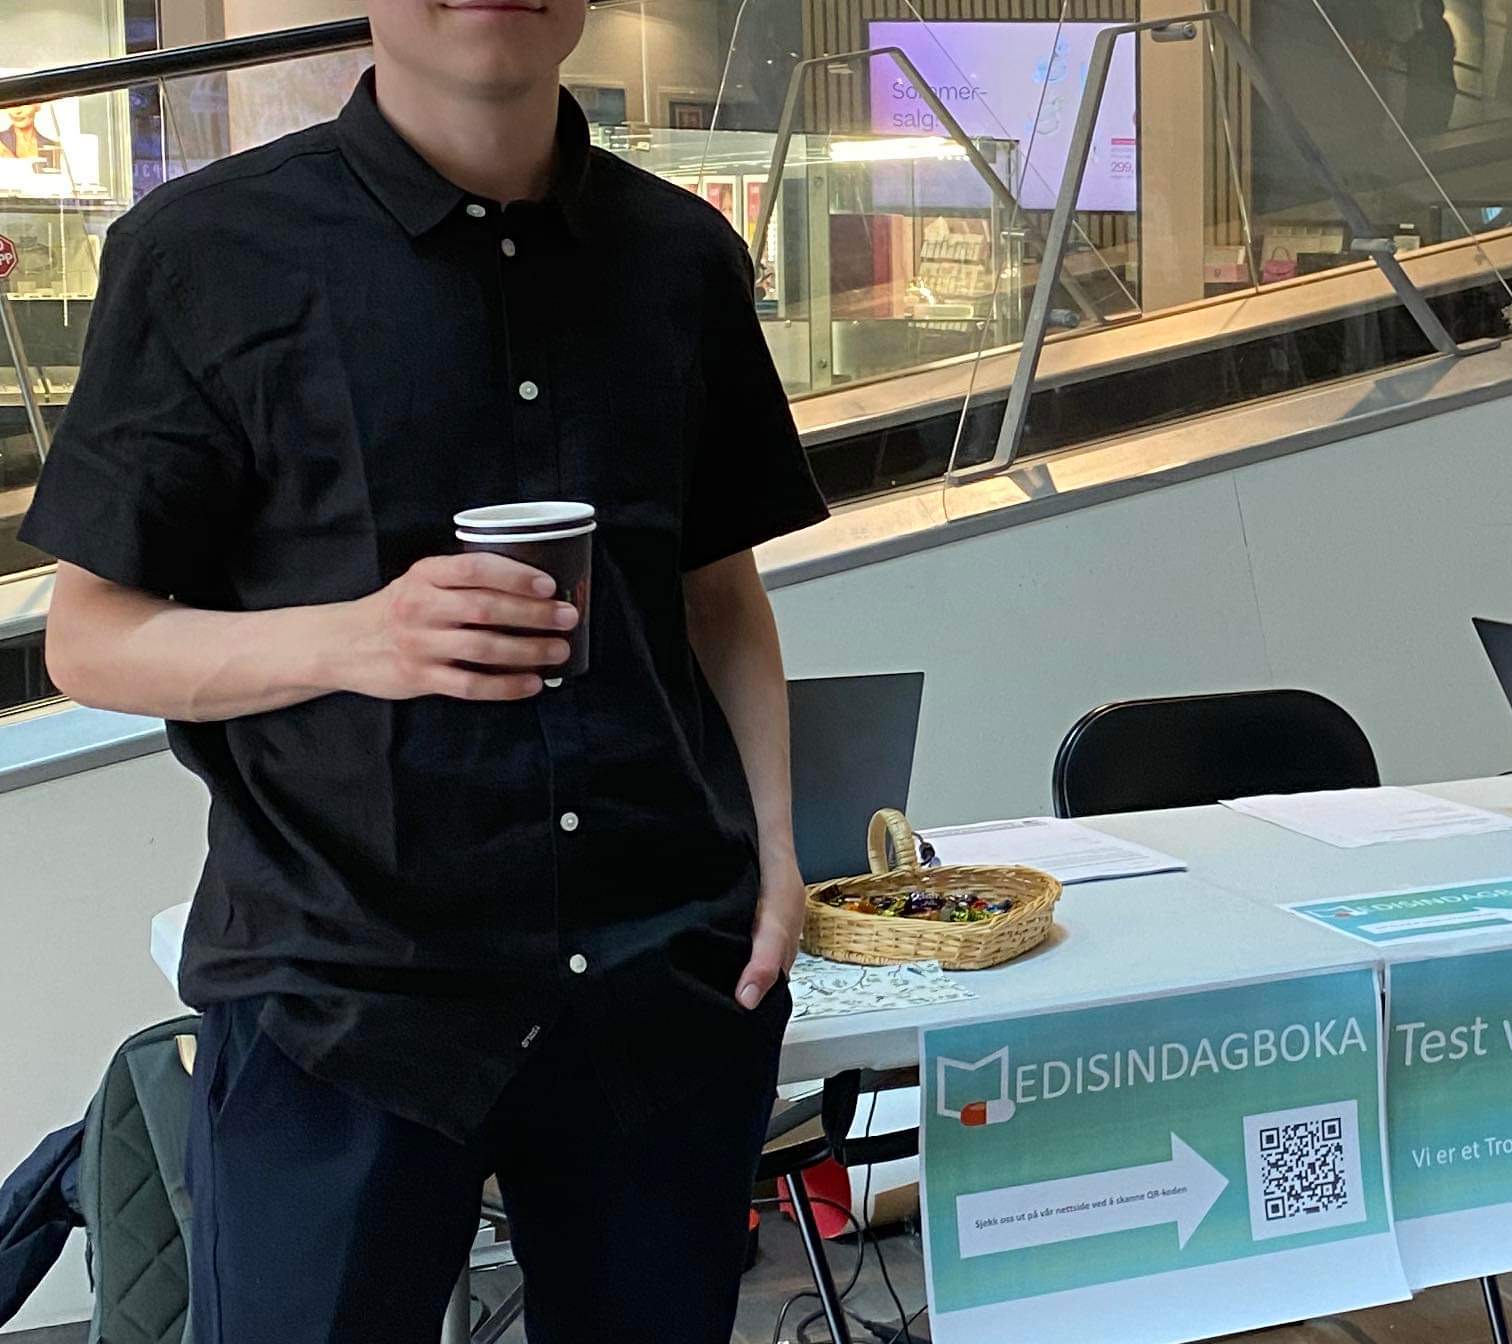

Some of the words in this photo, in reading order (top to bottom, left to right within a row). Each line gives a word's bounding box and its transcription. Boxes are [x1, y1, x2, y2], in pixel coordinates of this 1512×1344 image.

[892, 81, 988, 101] Somer-
[1395, 1017, 1488, 1066] Test
[1412, 1149, 1431, 1168] Vi
[1436, 1146, 1455, 1164] er
[1462, 1142, 1480, 1160] et
[975, 1218, 998, 1229] Sjekk
[1000, 1216, 1014, 1224] oss
[1016, 1213, 1025, 1221] ut
[1027, 1210, 1039, 1221] på
[1040, 1208, 1053, 1217] vår
[1055, 1202, 1090, 1215] nettside
[1092, 1198, 1107, 1208] ved
[1116, 1194, 1145, 1205] skanne
[1146, 1186, 1187, 1200] QR-koden
